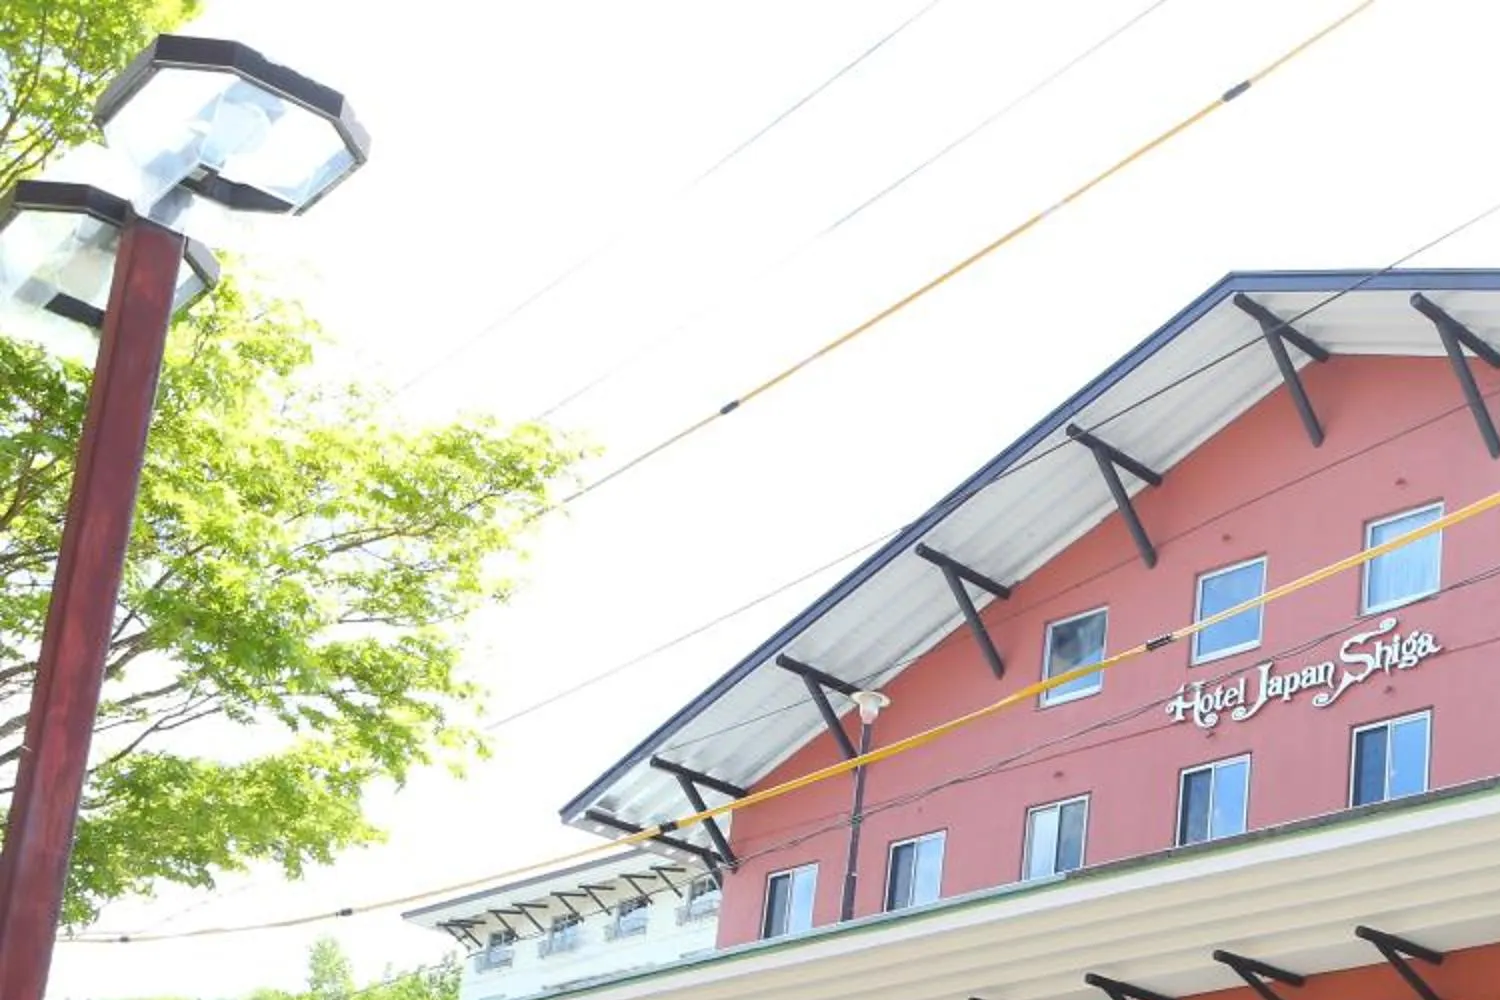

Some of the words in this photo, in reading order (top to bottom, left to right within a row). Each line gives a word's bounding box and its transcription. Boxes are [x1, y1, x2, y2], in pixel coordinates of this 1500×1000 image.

[1165, 676, 1246, 729] Hotel
[1231, 660, 1335, 722] Japan
[1311, 616, 1443, 708] Shiga
